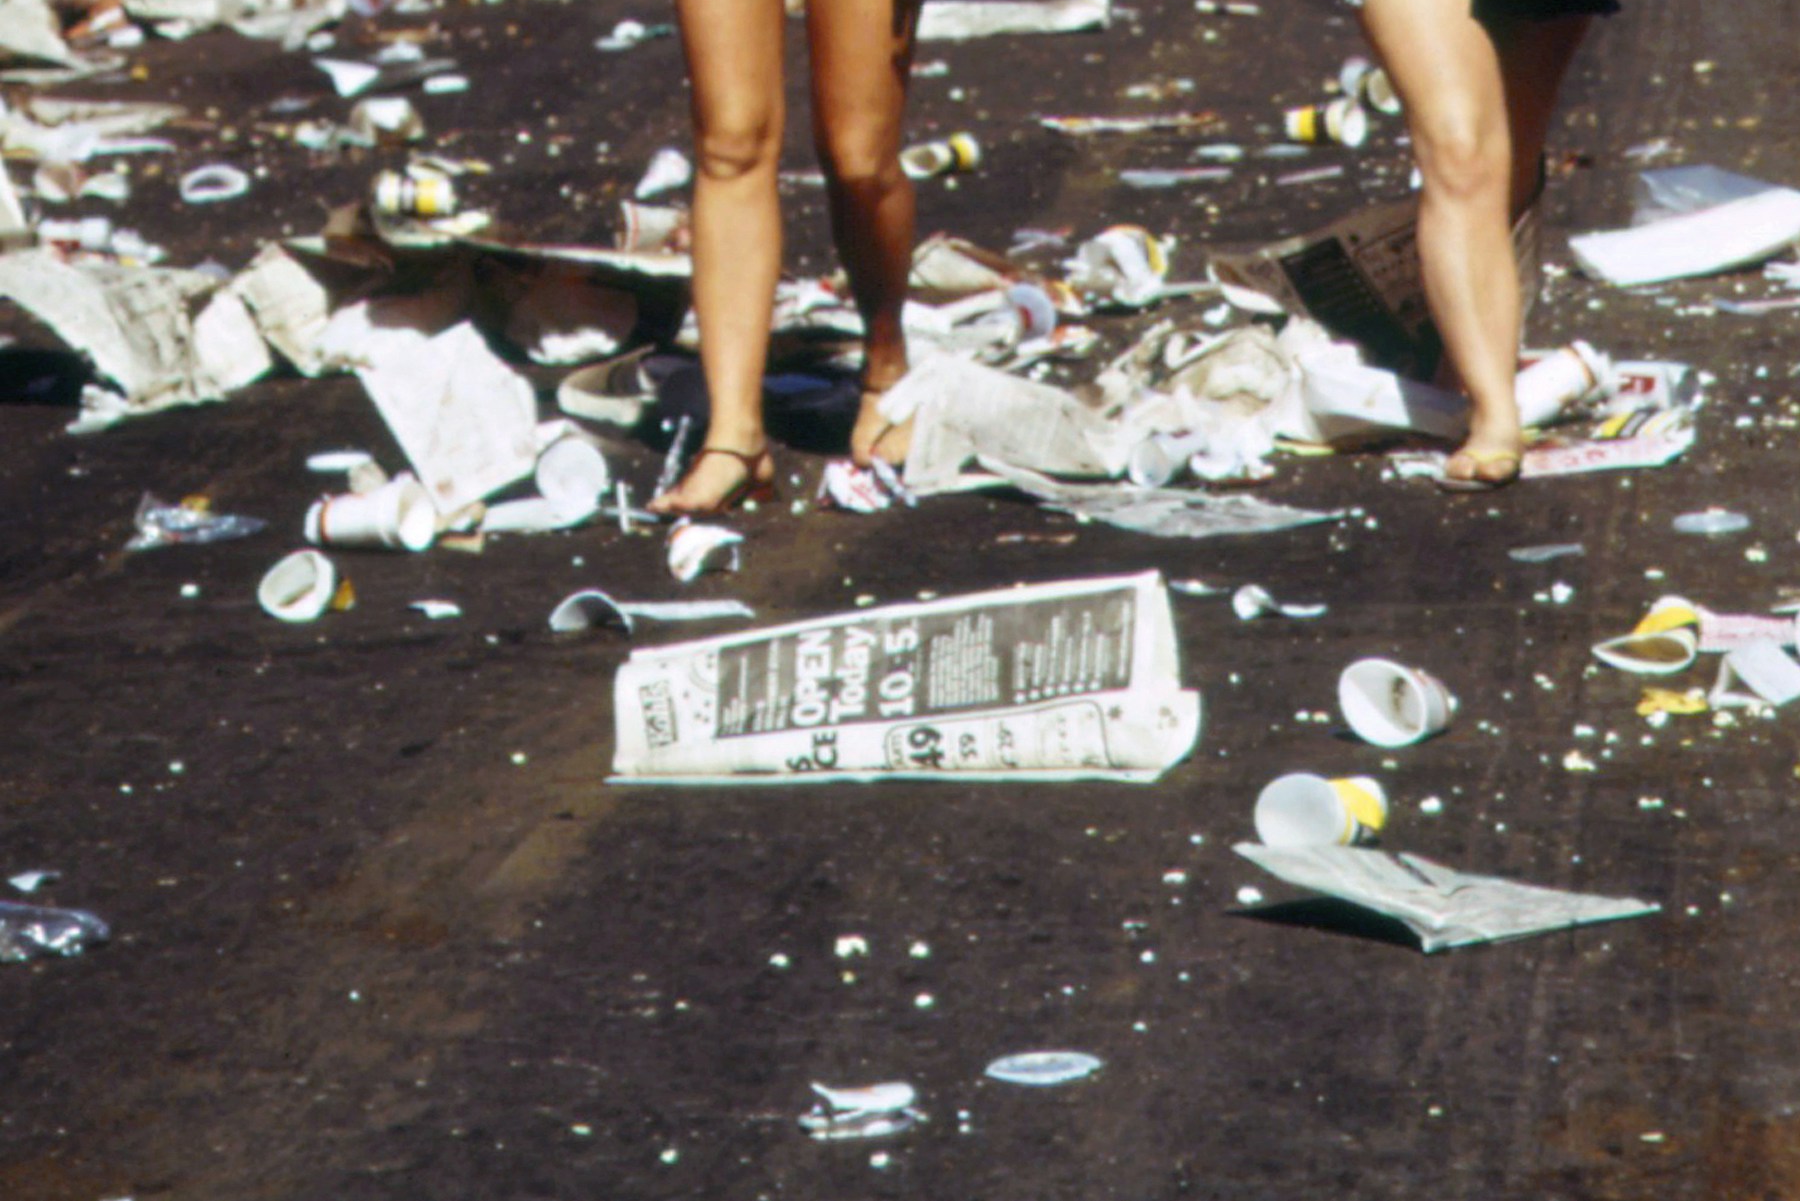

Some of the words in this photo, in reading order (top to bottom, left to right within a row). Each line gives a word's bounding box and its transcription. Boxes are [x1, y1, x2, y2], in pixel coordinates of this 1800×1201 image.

[883, 627, 919, 656] 5
[791, 629, 832, 727] OPEN
[829, 625, 878, 724] Today
[878, 670, 914, 717] 10
[906, 726, 944, 768] 49
